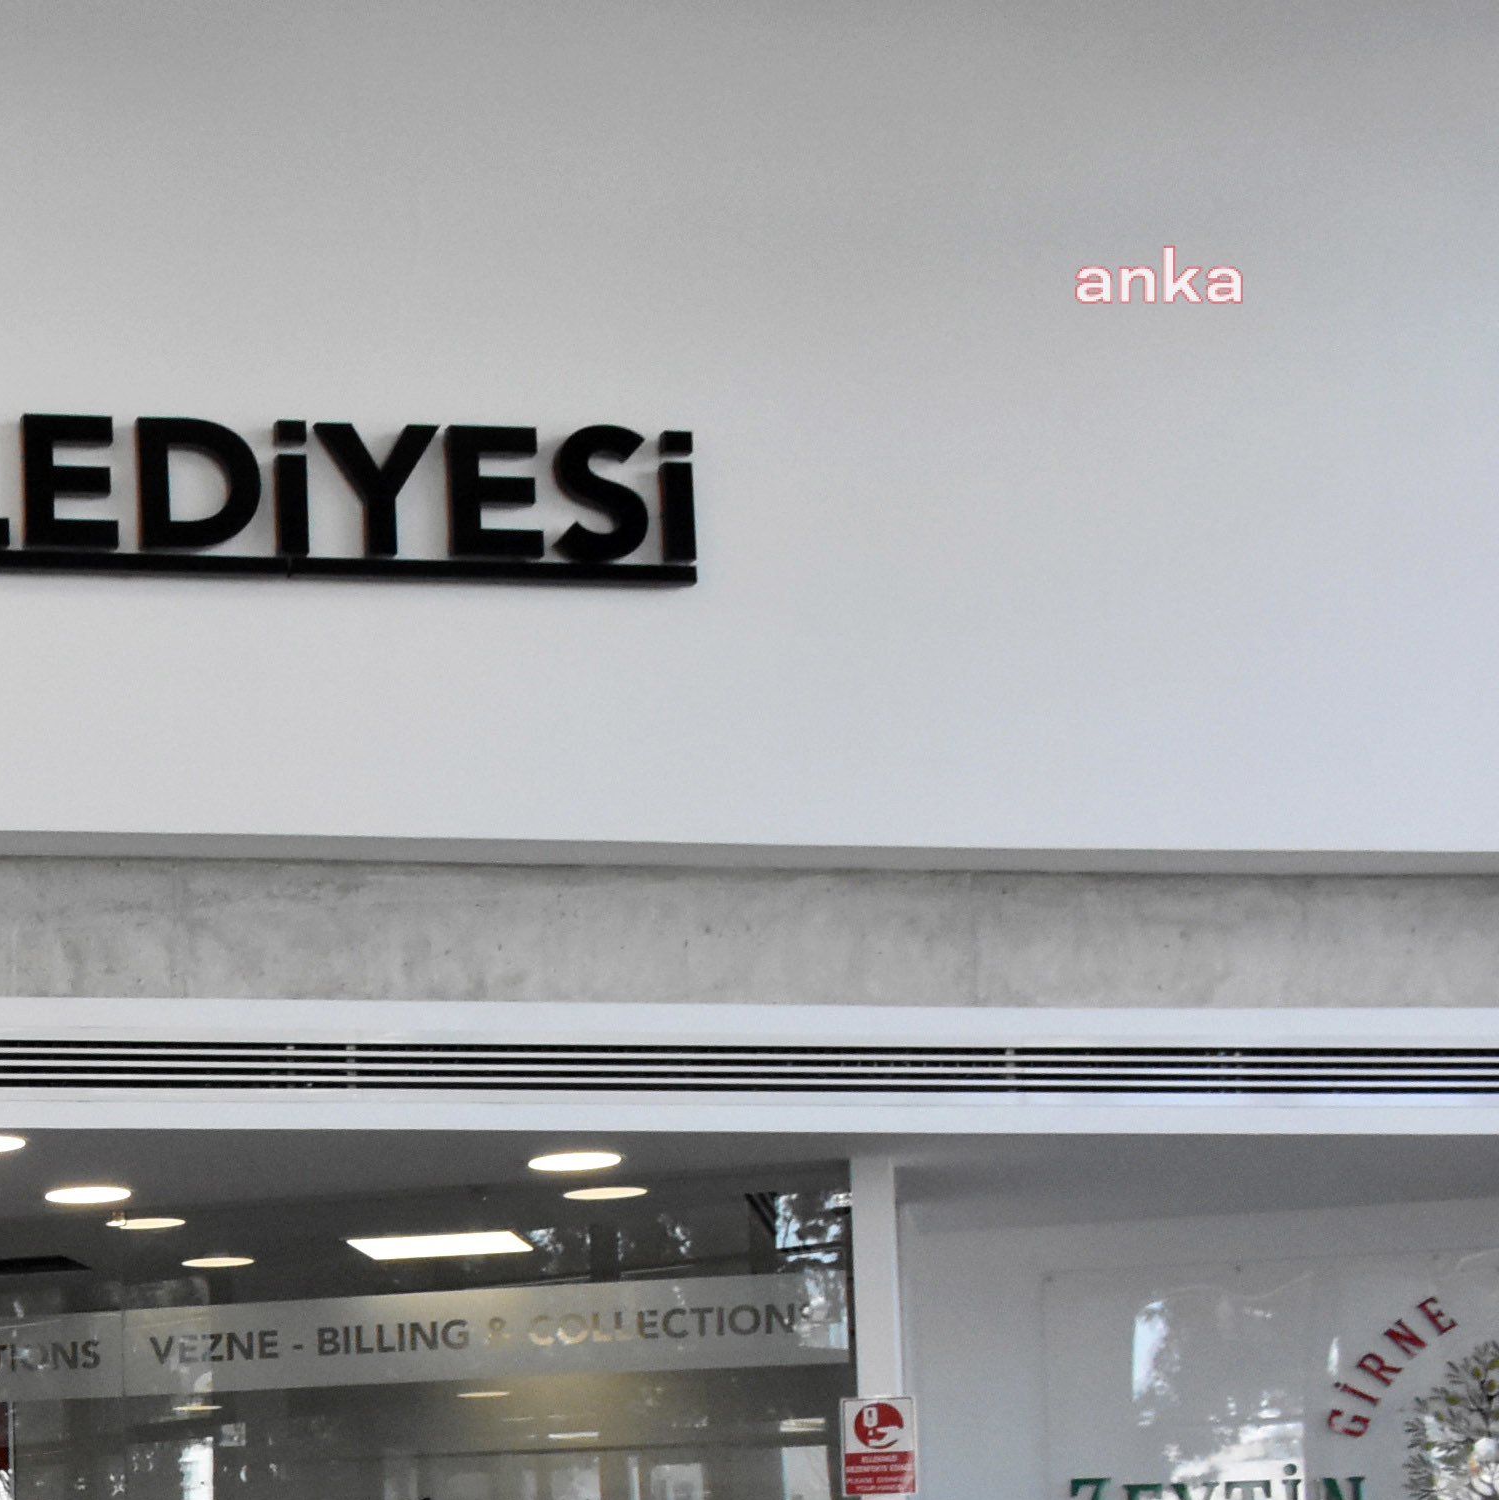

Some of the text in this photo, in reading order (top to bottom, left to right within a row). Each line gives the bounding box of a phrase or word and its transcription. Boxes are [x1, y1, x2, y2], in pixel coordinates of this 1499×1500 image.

[150, 1329, 281, 1365] VEZNE
[316, 1318, 471, 1358] BILLING
[1328, 1295, 1459, 1438] GİRNE
